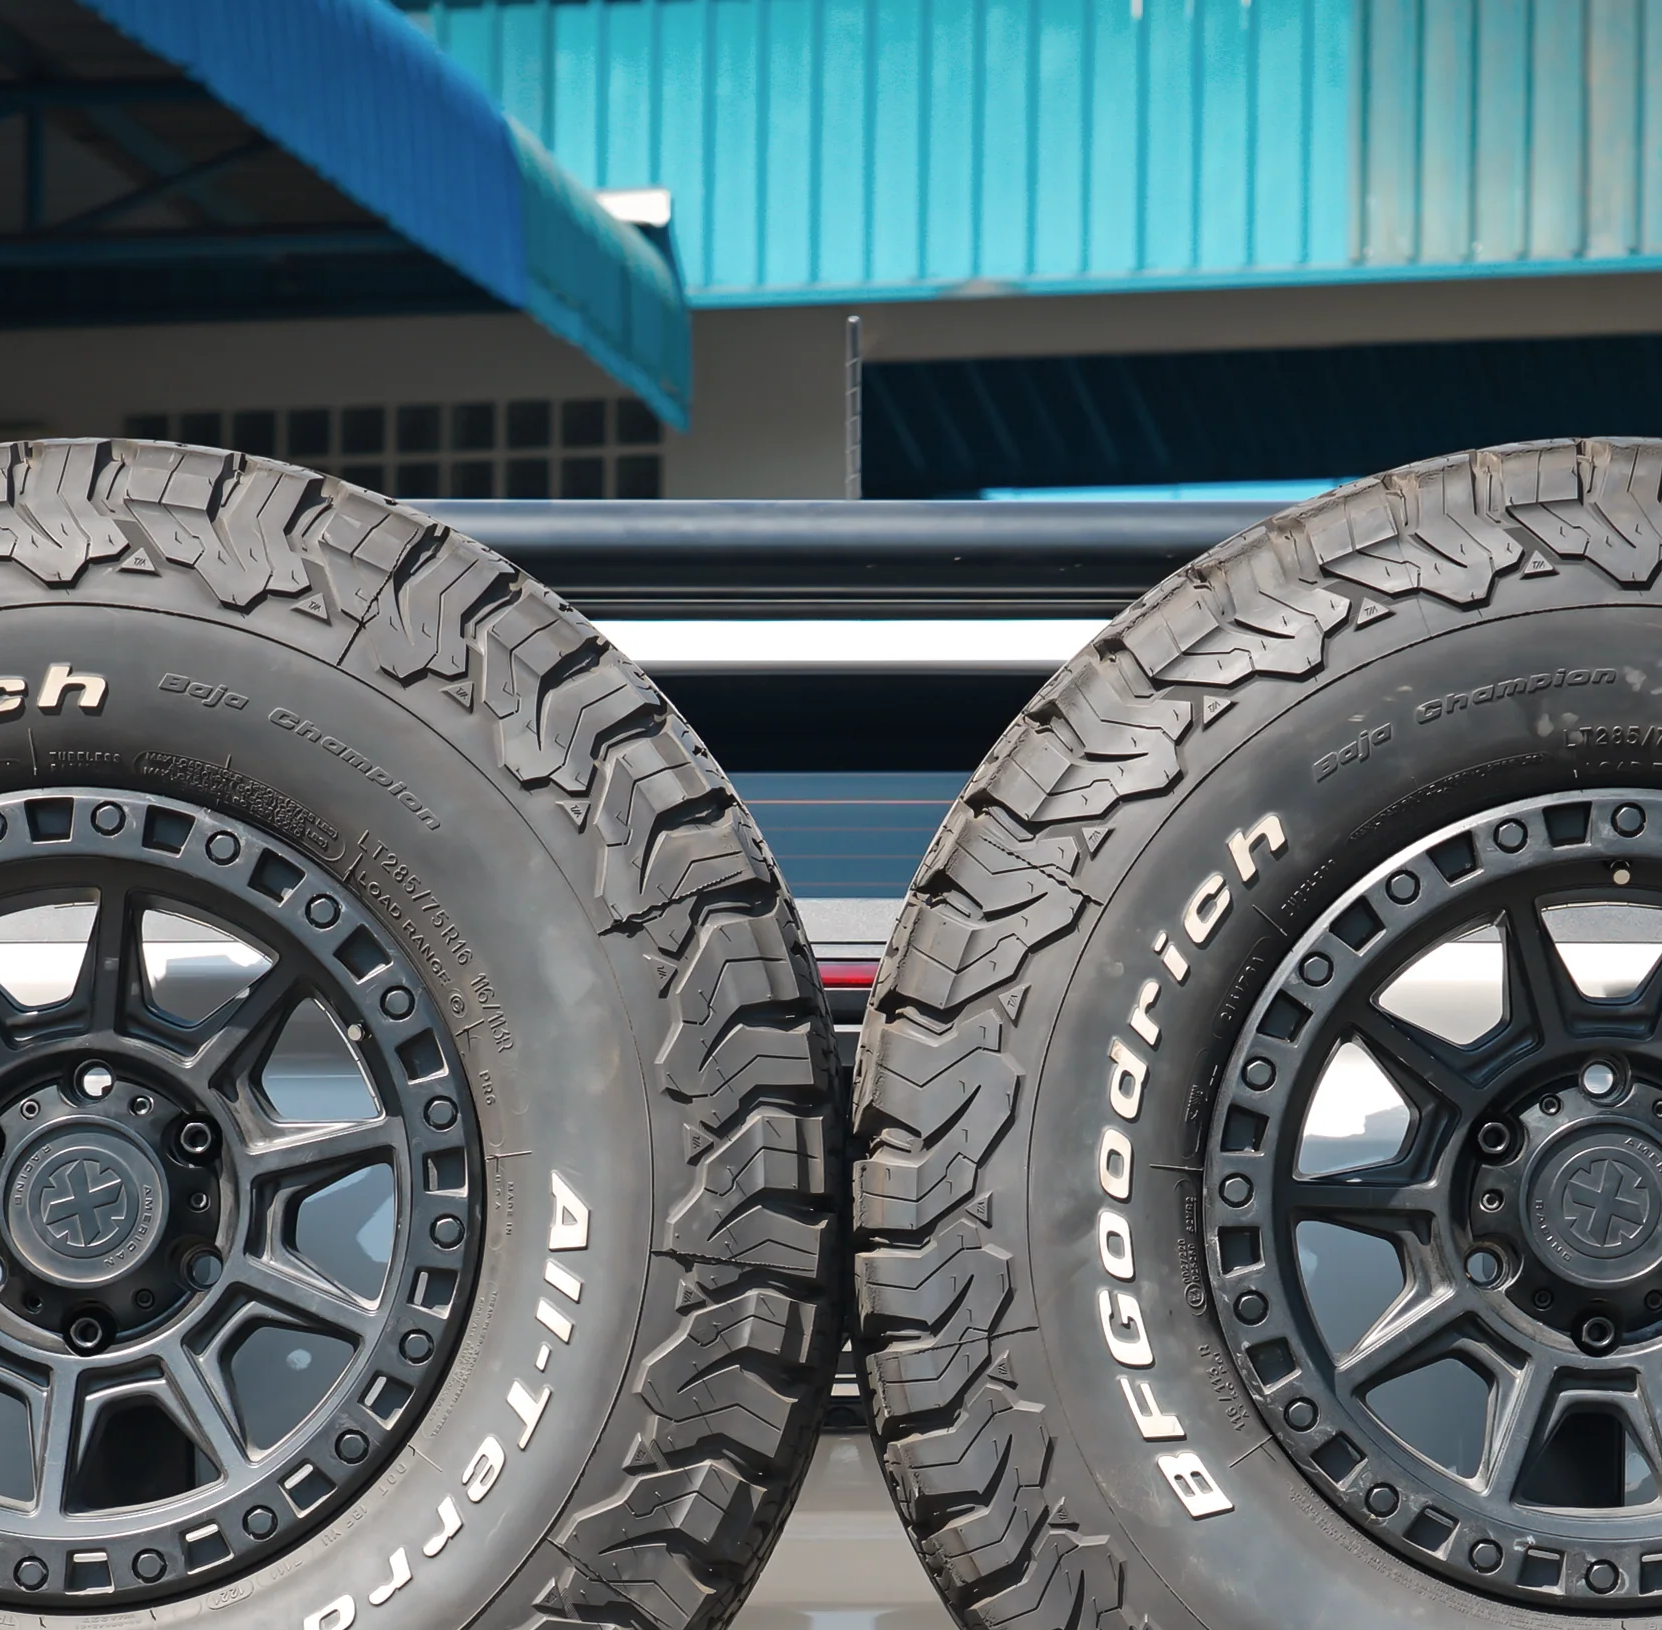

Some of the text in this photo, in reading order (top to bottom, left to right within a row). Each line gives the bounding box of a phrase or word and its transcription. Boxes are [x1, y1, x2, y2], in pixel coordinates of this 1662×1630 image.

[158, 673, 249, 709] Baja
[268, 707, 441, 831] Champion
[1312, 667, 1617, 782] Baja Champion
[358, 870, 402, 920] LOAD
[402, 919, 451, 987] RANGE
[14, 1144, 154, 1268] AMERICAN RACING
[1098, 813, 1287, 1519] BFGoodrich
[1536, 1200, 1572, 1262] RACING
[379, 1463, 406, 1496] DOT
